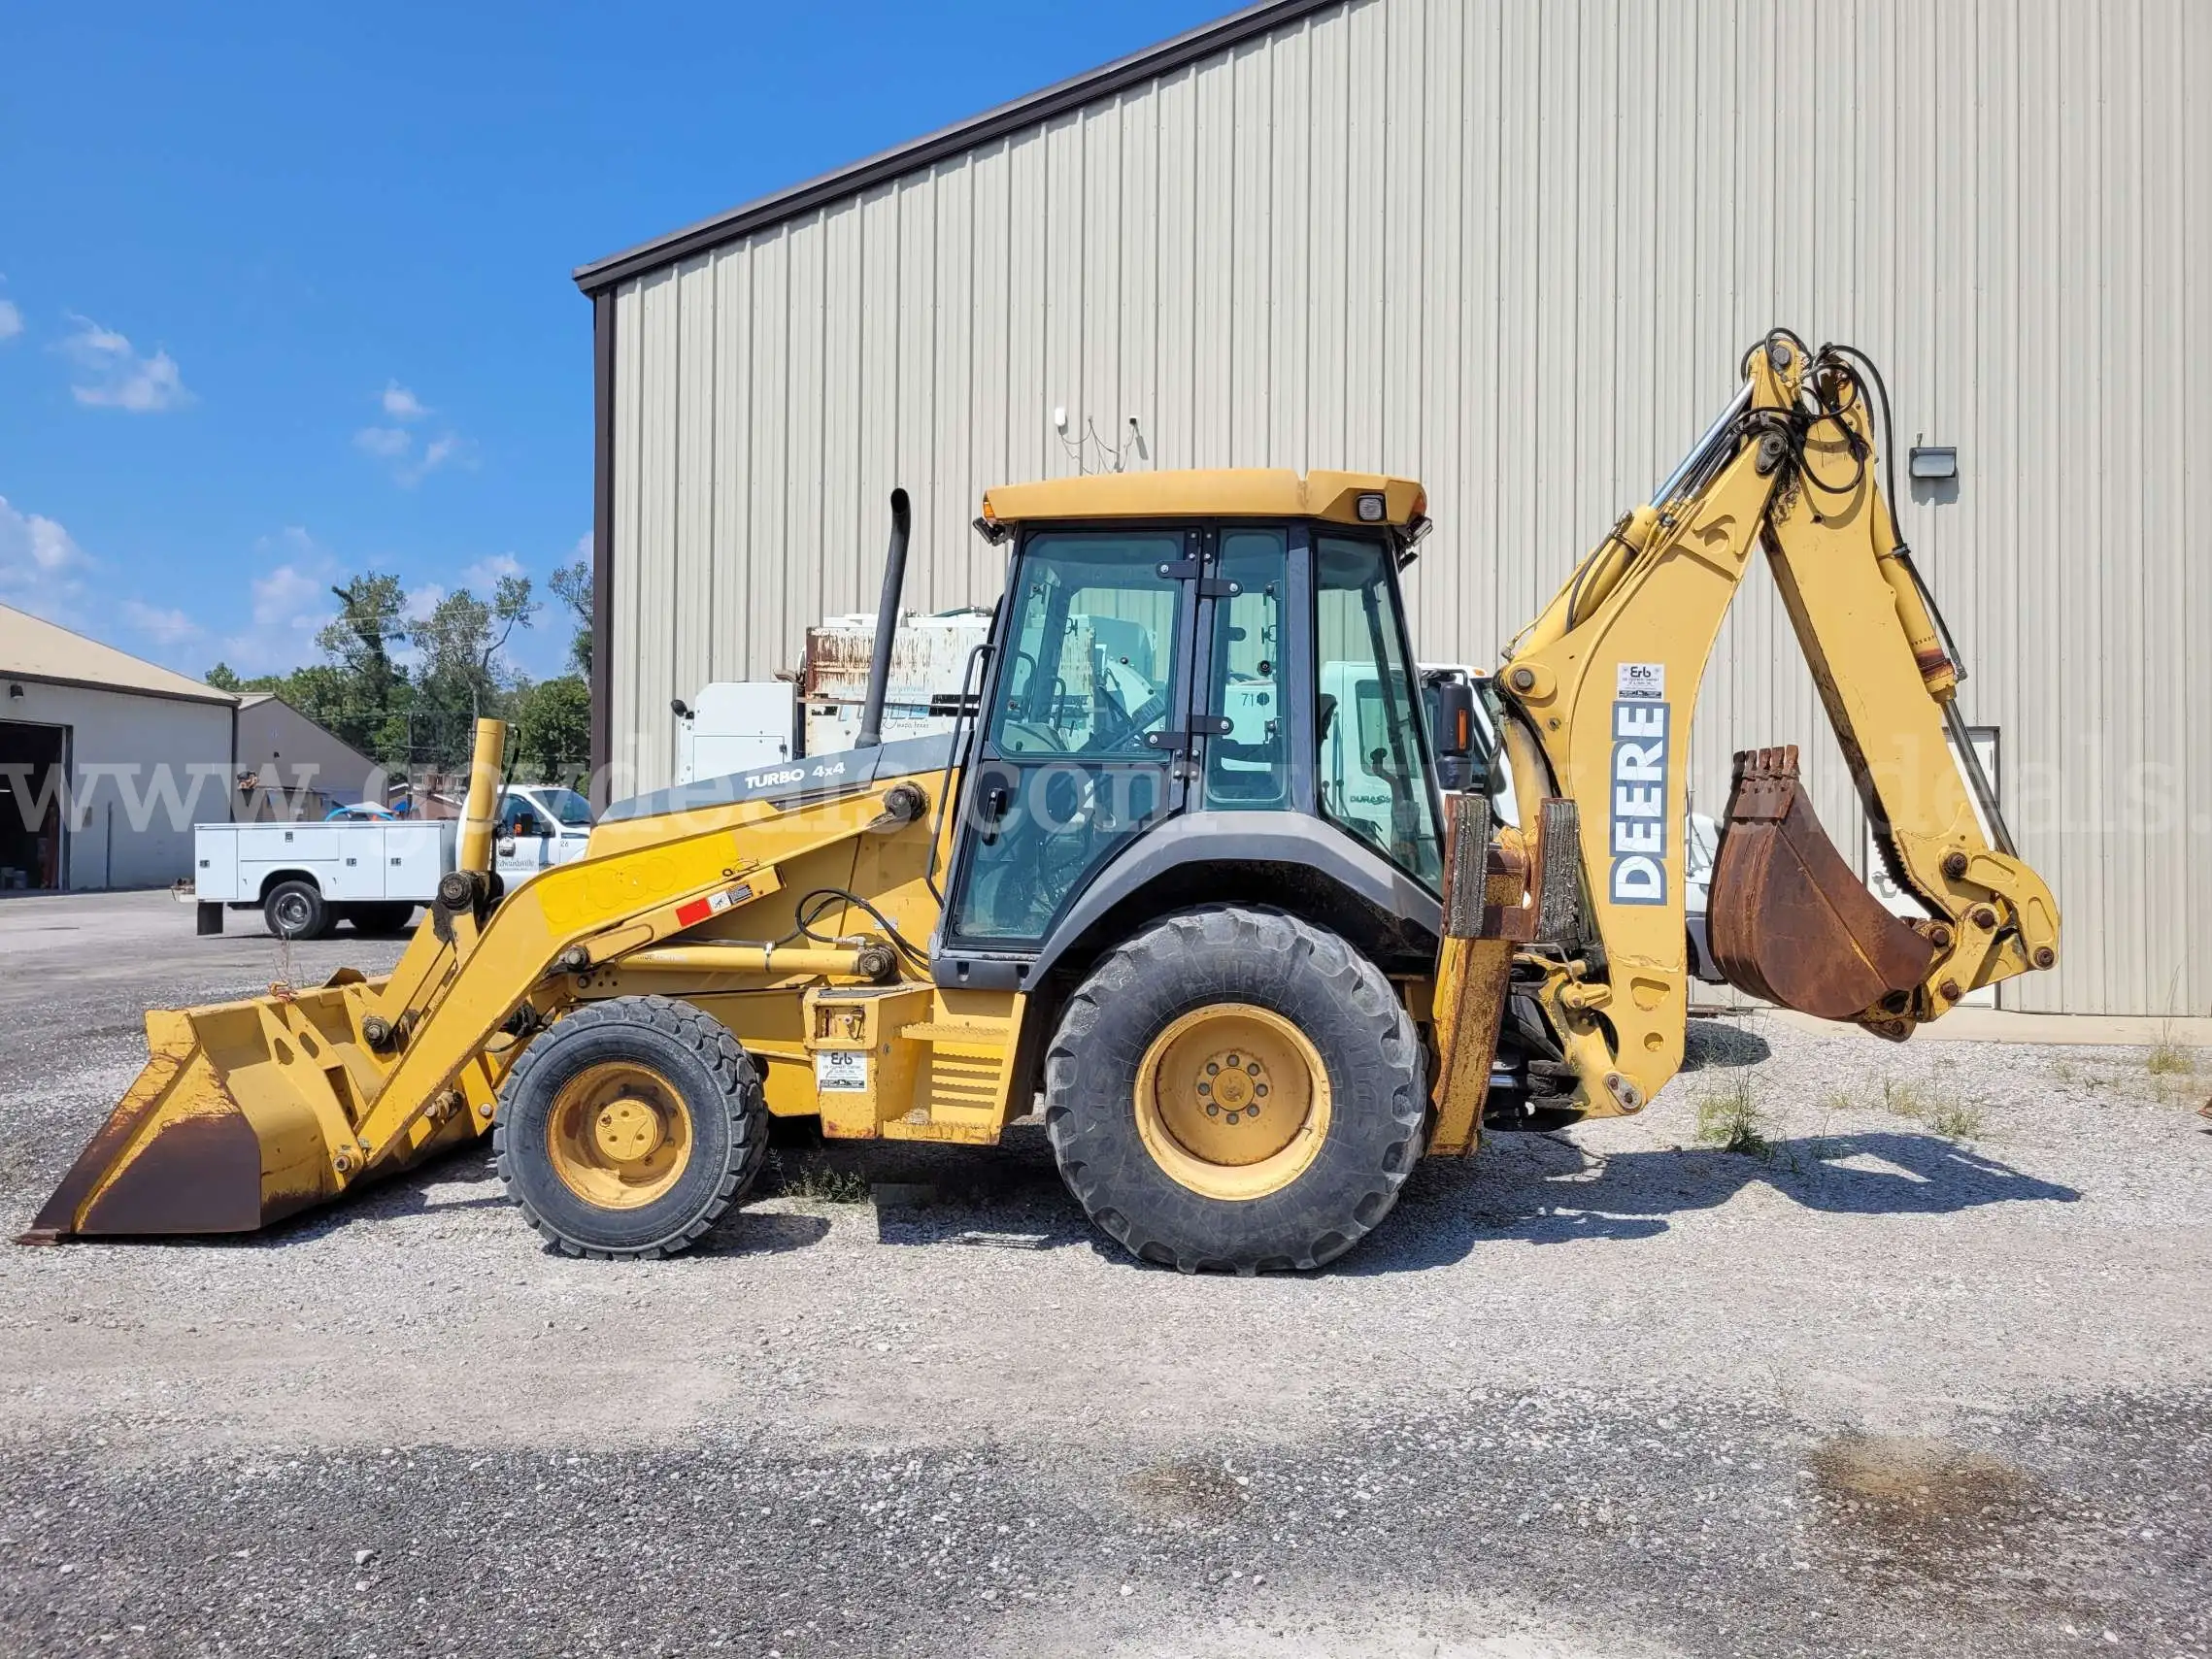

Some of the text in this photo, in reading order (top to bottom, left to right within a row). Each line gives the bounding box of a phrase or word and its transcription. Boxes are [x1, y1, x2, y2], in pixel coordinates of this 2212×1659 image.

[745, 761, 846, 789] TURBO 4x4
[1616, 707, 1663, 899] DEERE
